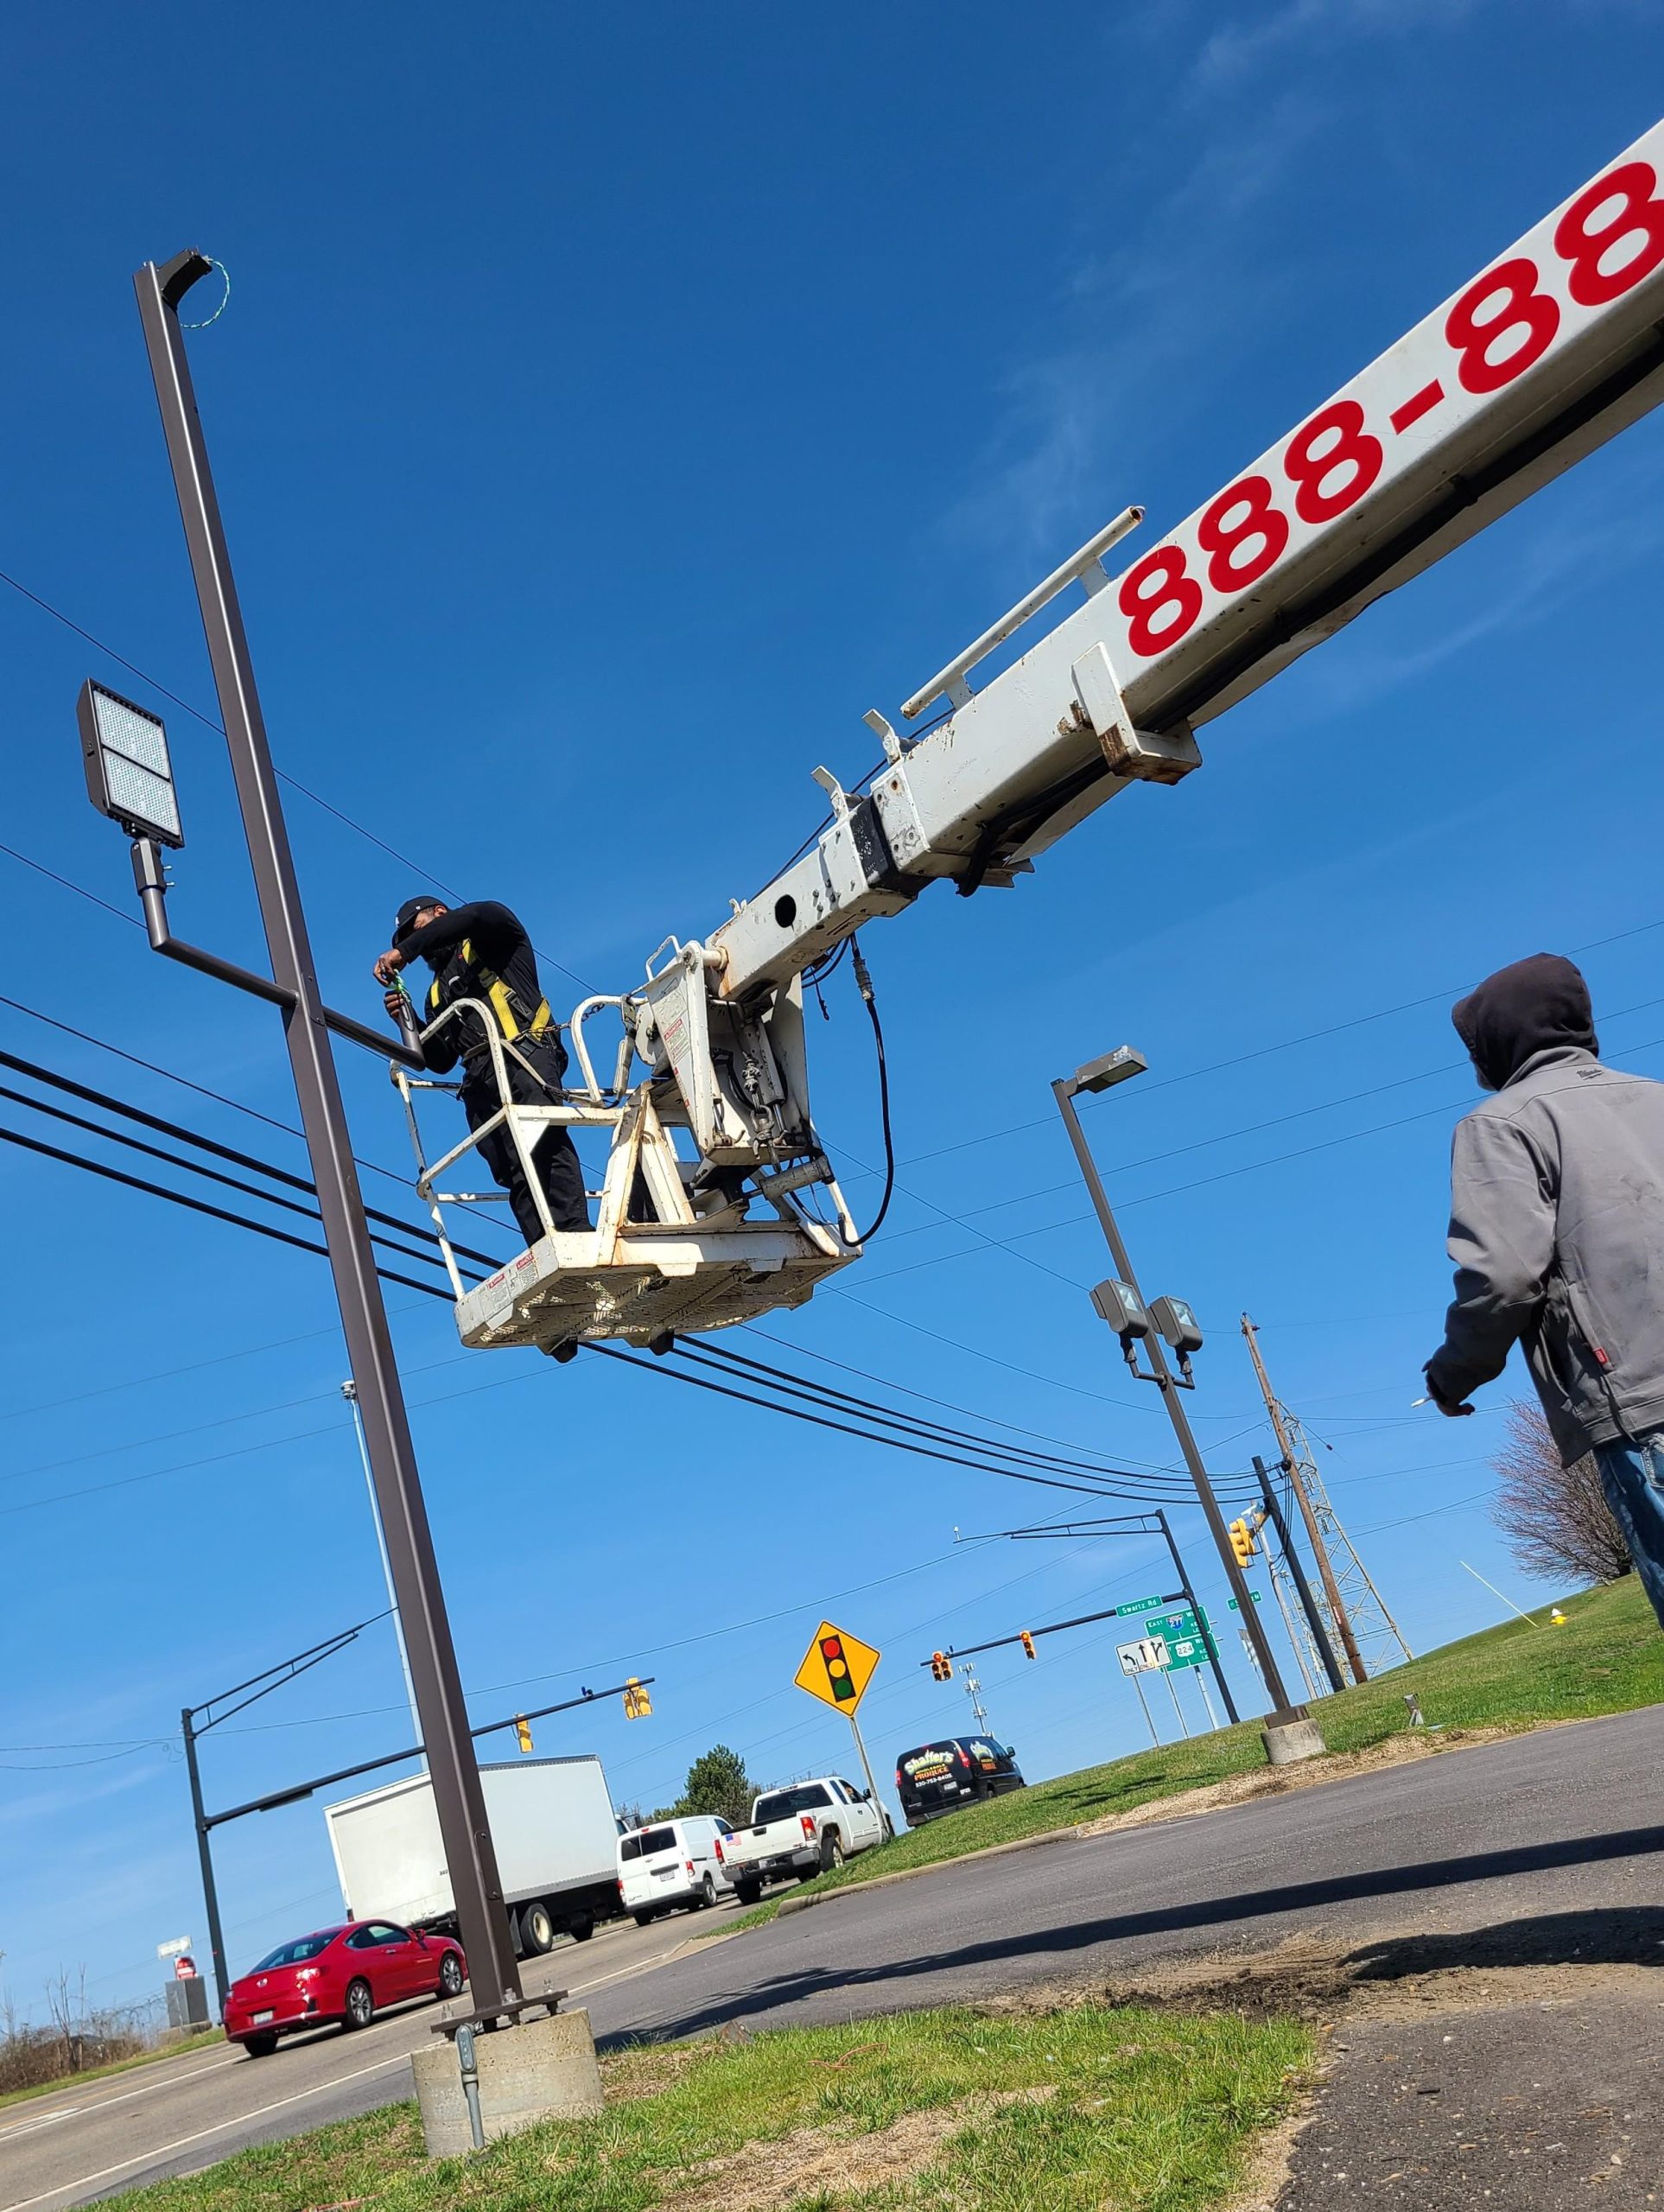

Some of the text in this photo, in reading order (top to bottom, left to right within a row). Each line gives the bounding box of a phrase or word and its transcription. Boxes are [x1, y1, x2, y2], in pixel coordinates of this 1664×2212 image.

[1118, 162, 1664, 657] 888-88
[1122, 1604, 1146, 1614] Swartz
[1148, 1619, 1163, 1628] EAST
[1170, 1618, 1183, 1628] 277
[1178, 1644, 1192, 1655] 224
[905, 1750, 955, 1775] Shaffer's
[914, 1766, 949, 1781] PRODUCE
